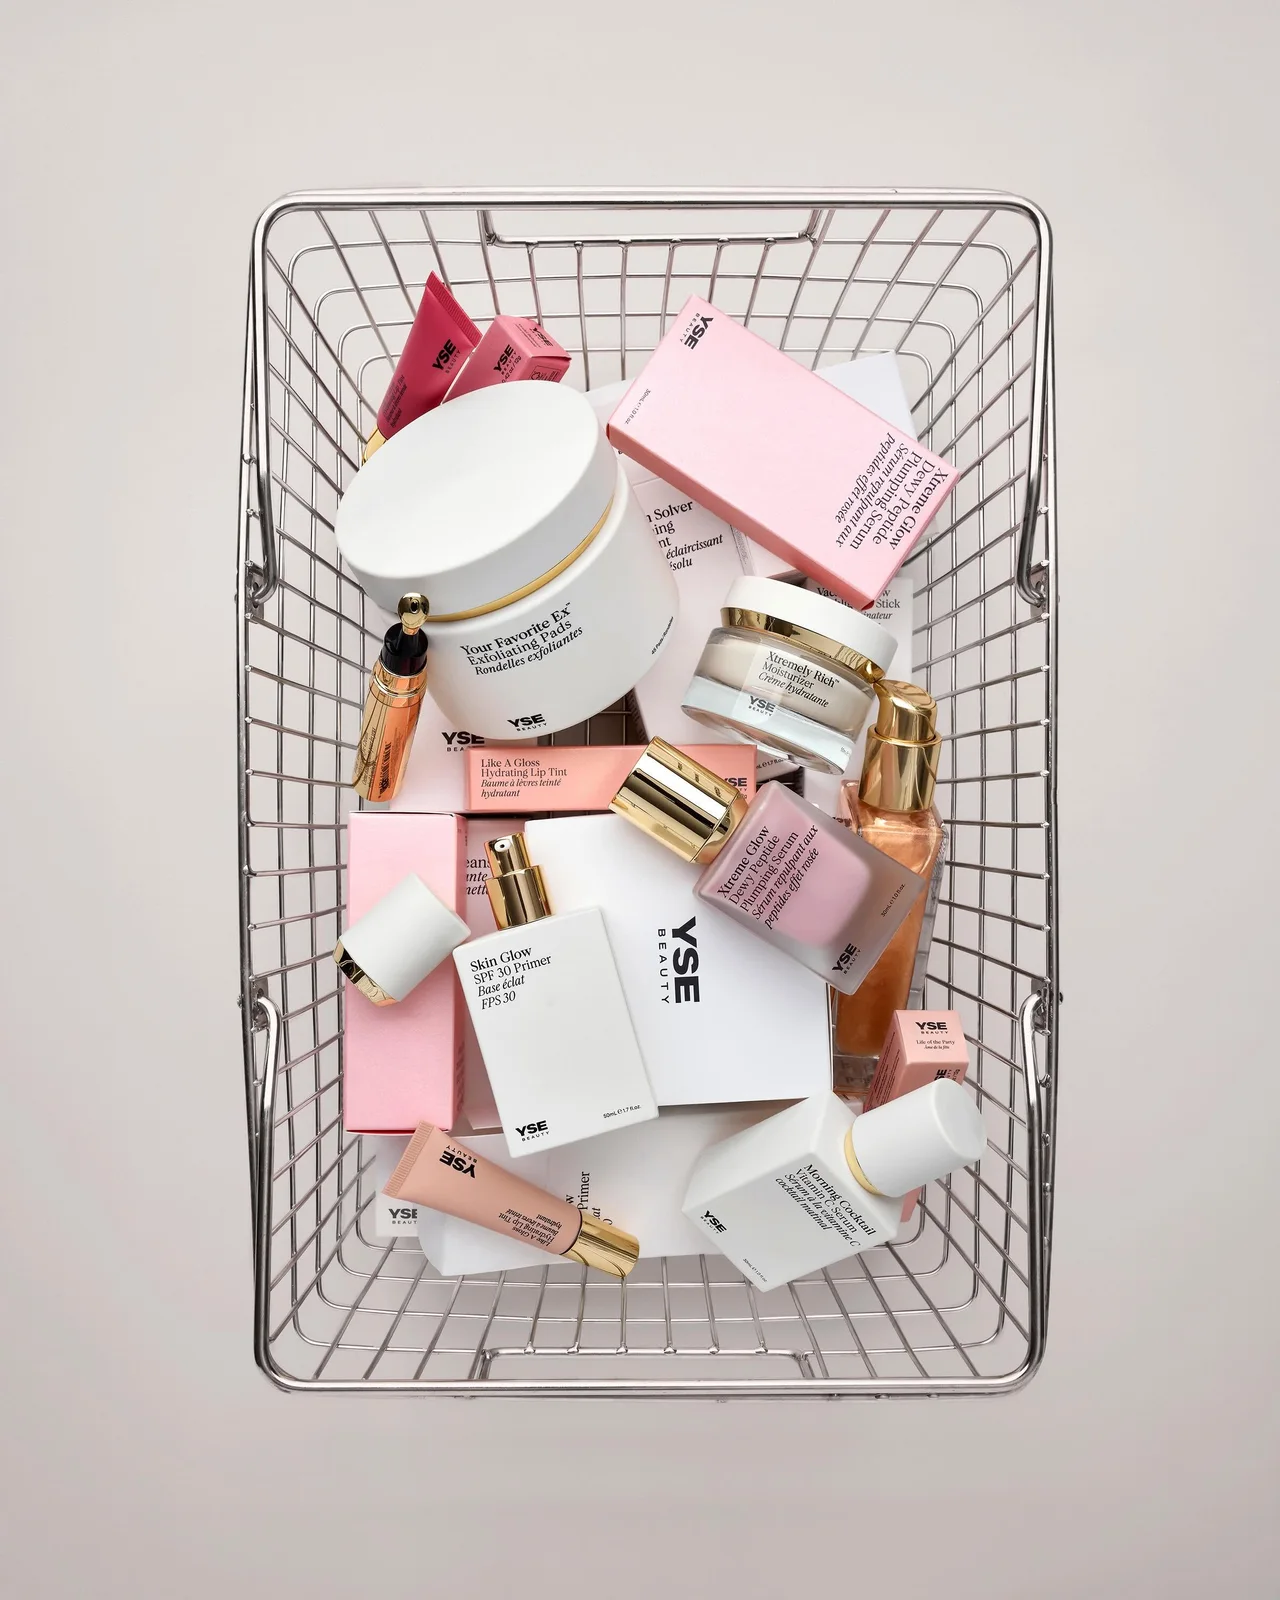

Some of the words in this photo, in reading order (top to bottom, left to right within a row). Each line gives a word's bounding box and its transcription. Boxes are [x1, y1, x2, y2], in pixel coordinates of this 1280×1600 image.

[680, 312, 700, 342] BEAUTY
[684, 316, 714, 350] YSE
[432, 339, 456, 370] YSE
[493, 344, 514, 372] YSE
[866, 432, 896, 476] peptides
[882, 443, 909, 478] Sérum
[852, 474, 869, 499] effet
[874, 451, 923, 510] Plumping
[904, 460, 935, 497] Dewy
[912, 468, 949, 515] Xtreme
[653, 501, 693, 521] Solver
[835, 497, 854, 523] rosée
[850, 476, 885, 527] repulpant
[850, 509, 883, 549] Serum
[872, 497, 910, 545] Peptide
[889, 515, 916, 550] Glow
[666, 534, 723, 560] éclaircissant
[835, 525, 852, 548] aux
[875, 598, 900, 609] Stick
[460, 642, 493, 656] Your
[494, 620, 550, 648] Favorite
[467, 638, 540, 665] Exfoliating
[540, 620, 572, 643] Pads
[475, 657, 525, 675] Rondelles
[527, 626, 583, 661] exfoliantes
[762, 661, 815, 689] Moisturizer
[766, 651, 813, 678] Xtremely
[758, 671, 786, 688] Crème
[785, 682, 829, 708] hydratante
[748, 705, 772, 717] BEAUTY
[749, 695, 776, 713] YSE
[507, 713, 546, 728] YSE
[516, 722, 547, 732] BEAUTY
[481, 758, 502, 767] Like
[504, 759, 511, 767] A
[514, 758, 540, 767] Gloss
[481, 768, 528, 779] Hydrating
[530, 768, 546, 779] Lip
[548, 767, 567, 776] Tint
[480, 779, 509, 787] Baume
[509, 779, 515, 787] à
[516, 778, 538, 787] lèvres
[539, 778, 561, 787] teinté
[480, 789, 520, 799] hydratant
[725, 777, 747, 787] SE
[717, 857, 750, 898] Xtreme
[745, 826, 770, 856] Glow
[728, 874, 755, 905] Dewy
[750, 835, 780, 874] Peptide
[740, 864, 778, 912] Plumping
[771, 831, 799, 865] Serum
[751, 887, 776, 920] Sérum
[774, 844, 805, 889] repulpant
[803, 825, 819, 846] aux
[764, 890, 791, 930] peptides
[788, 870, 804, 892] effet
[801, 848, 819, 872] rosée
[470, 957, 498, 972] Skin
[500, 947, 532, 963] Glow
[473, 969, 494, 985] SPF
[497, 965, 512, 978] 30
[513, 955, 551, 973] Primer
[658, 928, 669, 1004] BEAUTY
[672, 916, 700, 1003] YSE
[832, 943, 857, 972] YSE
[843, 949, 861, 974] BEAUTY
[478, 982, 501, 997] Base
[502, 974, 525, 990] éclat
[482, 995, 501, 1010] FPS
[503, 990, 516, 1004] 30
[915, 1021, 948, 1030] YSE
[515, 1120, 548, 1137] YSE
[603, 1111, 617, 1119] 50mL
[521, 1131, 550, 1142] BEAUTY
[439, 1150, 476, 1178] YSE
[446, 1144, 477, 1163] BEAUTY
[577, 1171, 590, 1210] Primer
[775, 1178, 803, 1204] cocktail
[800, 1202, 833, 1231] matinal
[795, 1168, 826, 1199] Vitamin
[824, 1199, 834, 1207] C
[829, 1203, 858, 1234] Serum
[804, 1164, 842, 1201] Morning
[839, 1200, 876, 1236] Cocktail
[498, 1212, 512, 1224] Tint
[512, 1218, 524, 1229] Lip
[704, 1210, 727, 1233] YSE
[784, 1173, 810, 1197] Sérum
[807, 1194, 814, 1202] à
[812, 1200, 823, 1210] la
[820, 1208, 853, 1241] vitamine
[849, 1239, 861, 1248] C
[512, 1226, 529, 1237] Gloss
[524, 1223, 555, 1243] Hydrating
[536, 1236, 551, 1247] Like
